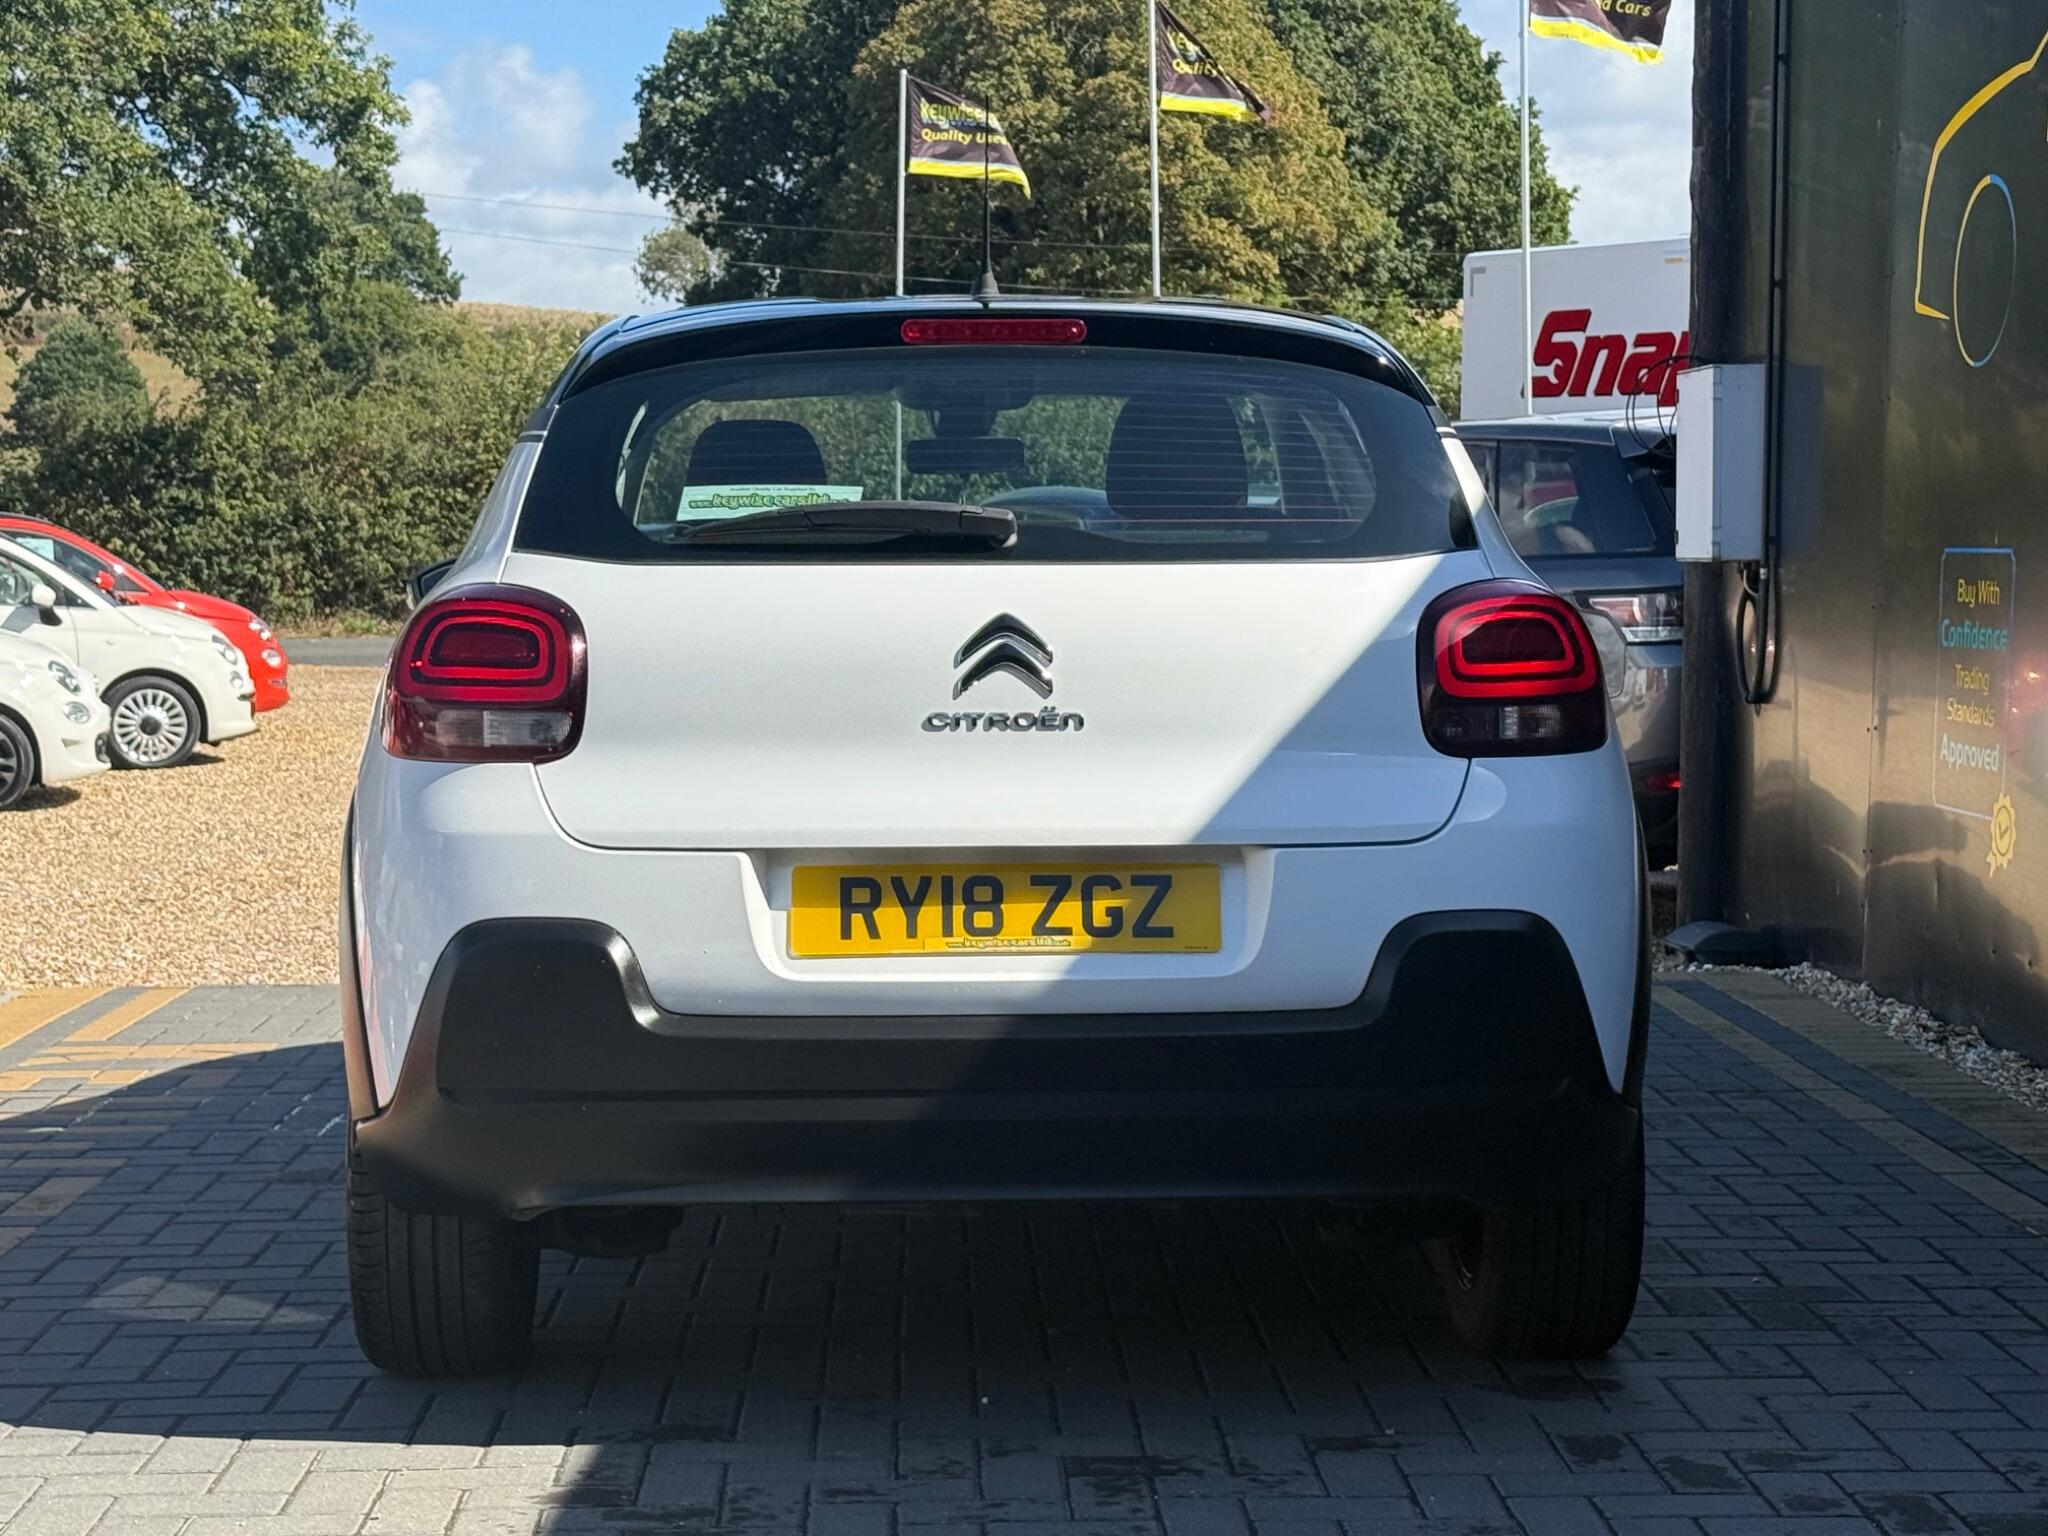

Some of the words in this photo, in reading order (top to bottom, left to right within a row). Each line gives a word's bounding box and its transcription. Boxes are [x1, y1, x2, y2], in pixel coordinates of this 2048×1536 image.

[1615, 0, 1652, 17] Cars
[921, 128, 973, 145] Quality
[1957, 579, 1976, 608] Buy
[1978, 580, 2001, 604] With
[1941, 619, 2008, 651] Confidence
[1955, 664, 1990, 695] Trading
[921, 706, 1085, 732] CITROËN
[1947, 698, 1995, 727] Standards
[1940, 733, 2000, 772] Approved
[839, 874, 1005, 940] RY18
[1029, 874, 1175, 938] ZGZ
